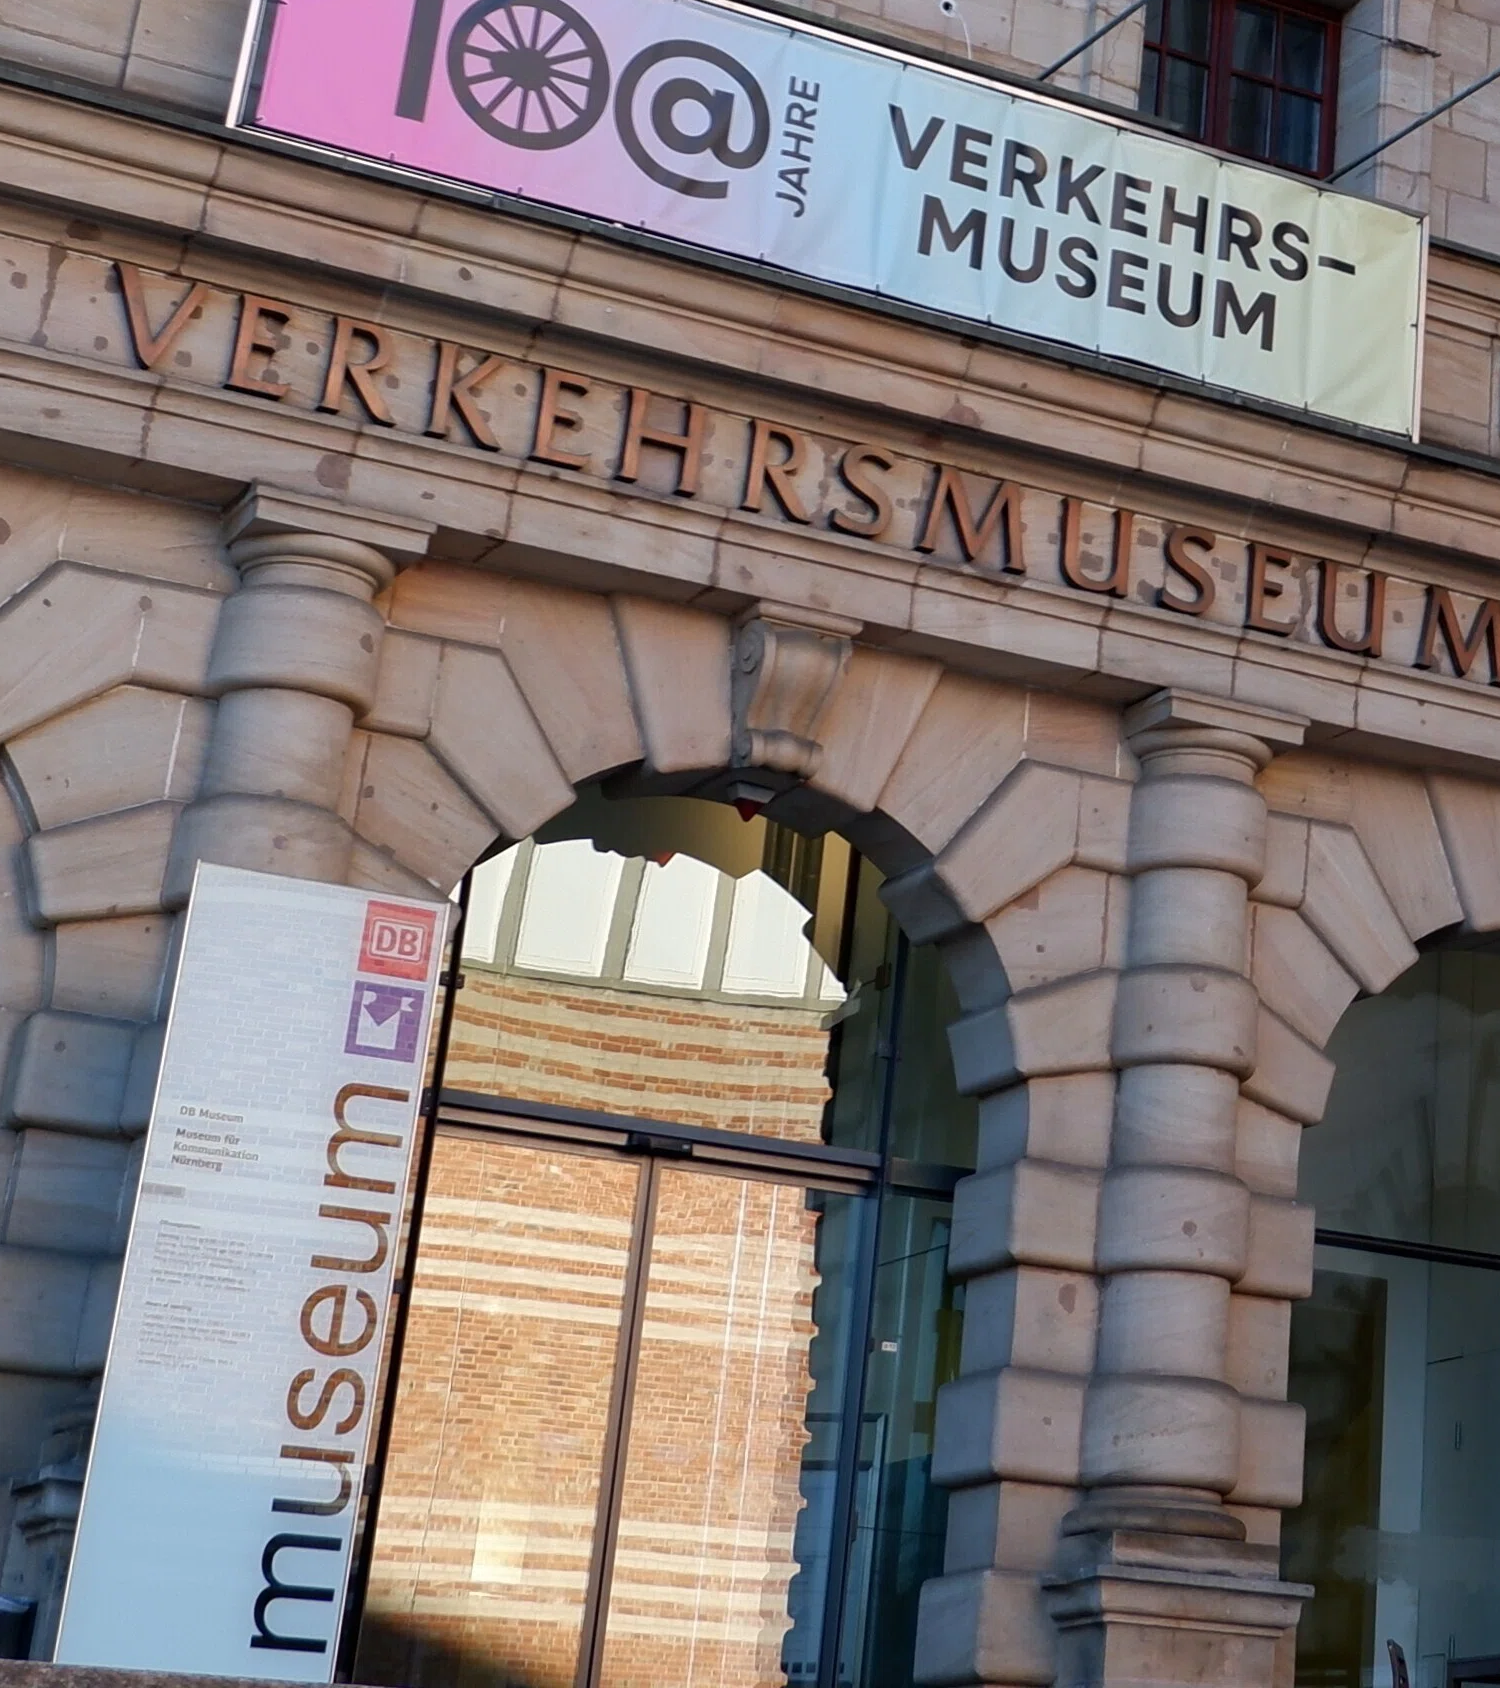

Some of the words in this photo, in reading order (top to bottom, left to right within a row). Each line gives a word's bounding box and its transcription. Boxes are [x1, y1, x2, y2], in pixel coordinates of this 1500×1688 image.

[775, 75, 821, 219] JAHRE
[917, 194, 1281, 352] MUSEUM
[375, 924, 419, 957] DB
[179, 1105, 197, 1117] DB
[199, 1108, 244, 1124] Museum
[175, 1128, 222, 1143] Museum
[223, 1134, 241, 1146] für
[170, 1154, 224, 1173] Nürnberg
[173, 1140, 260, 1162] Kommunikation
[249, 1080, 412, 1655] museum
